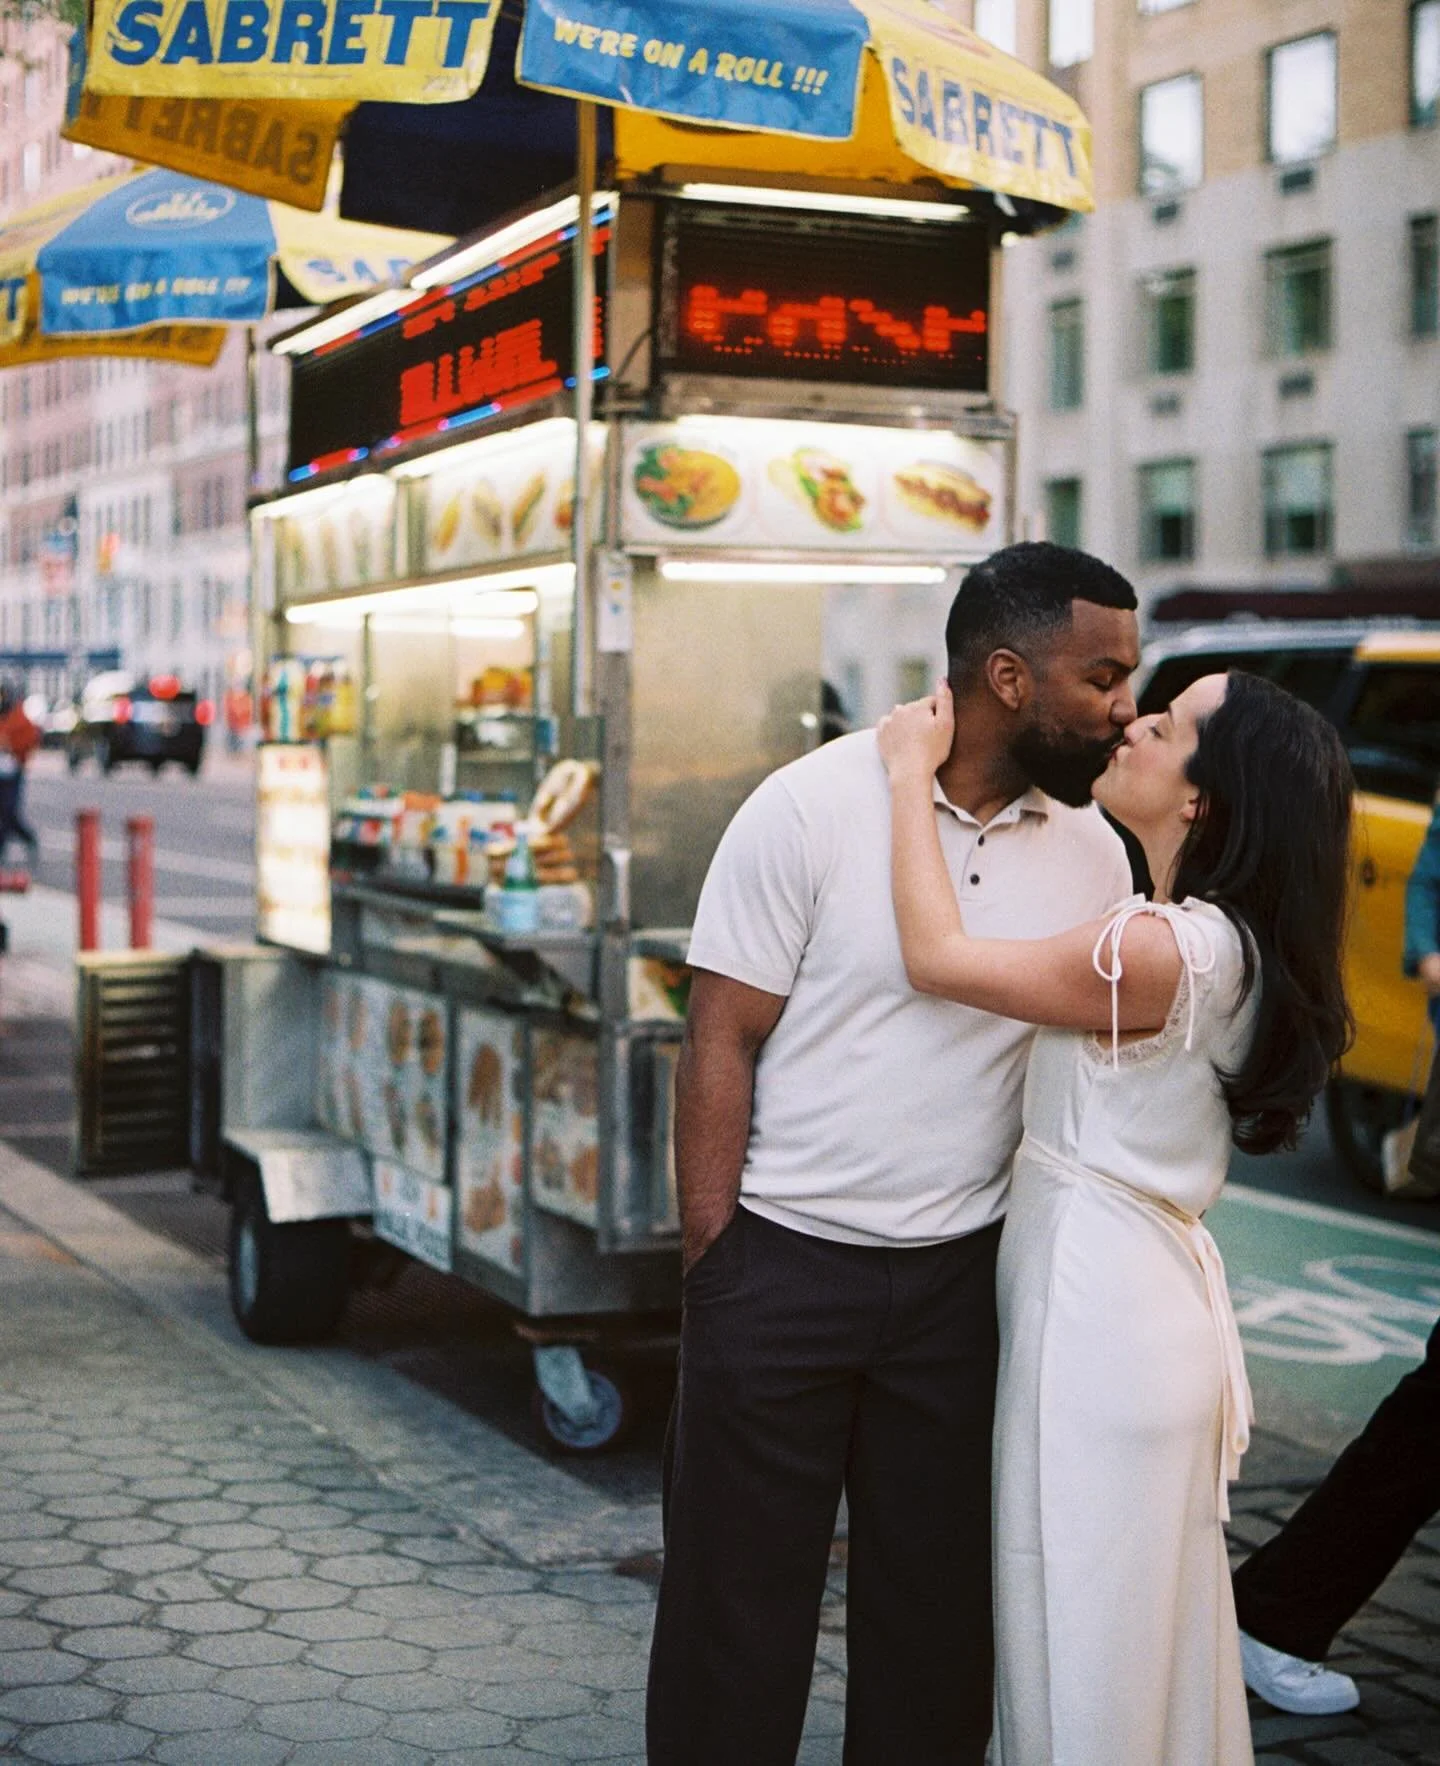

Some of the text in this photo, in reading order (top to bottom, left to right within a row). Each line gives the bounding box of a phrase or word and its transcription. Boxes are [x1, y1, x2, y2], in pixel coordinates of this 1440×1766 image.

[110, 0, 491, 68] SABRETT
[554, 17, 829, 96] WE'RE ON A ROLL !!!
[891, 56, 1077, 177] SABRETT
